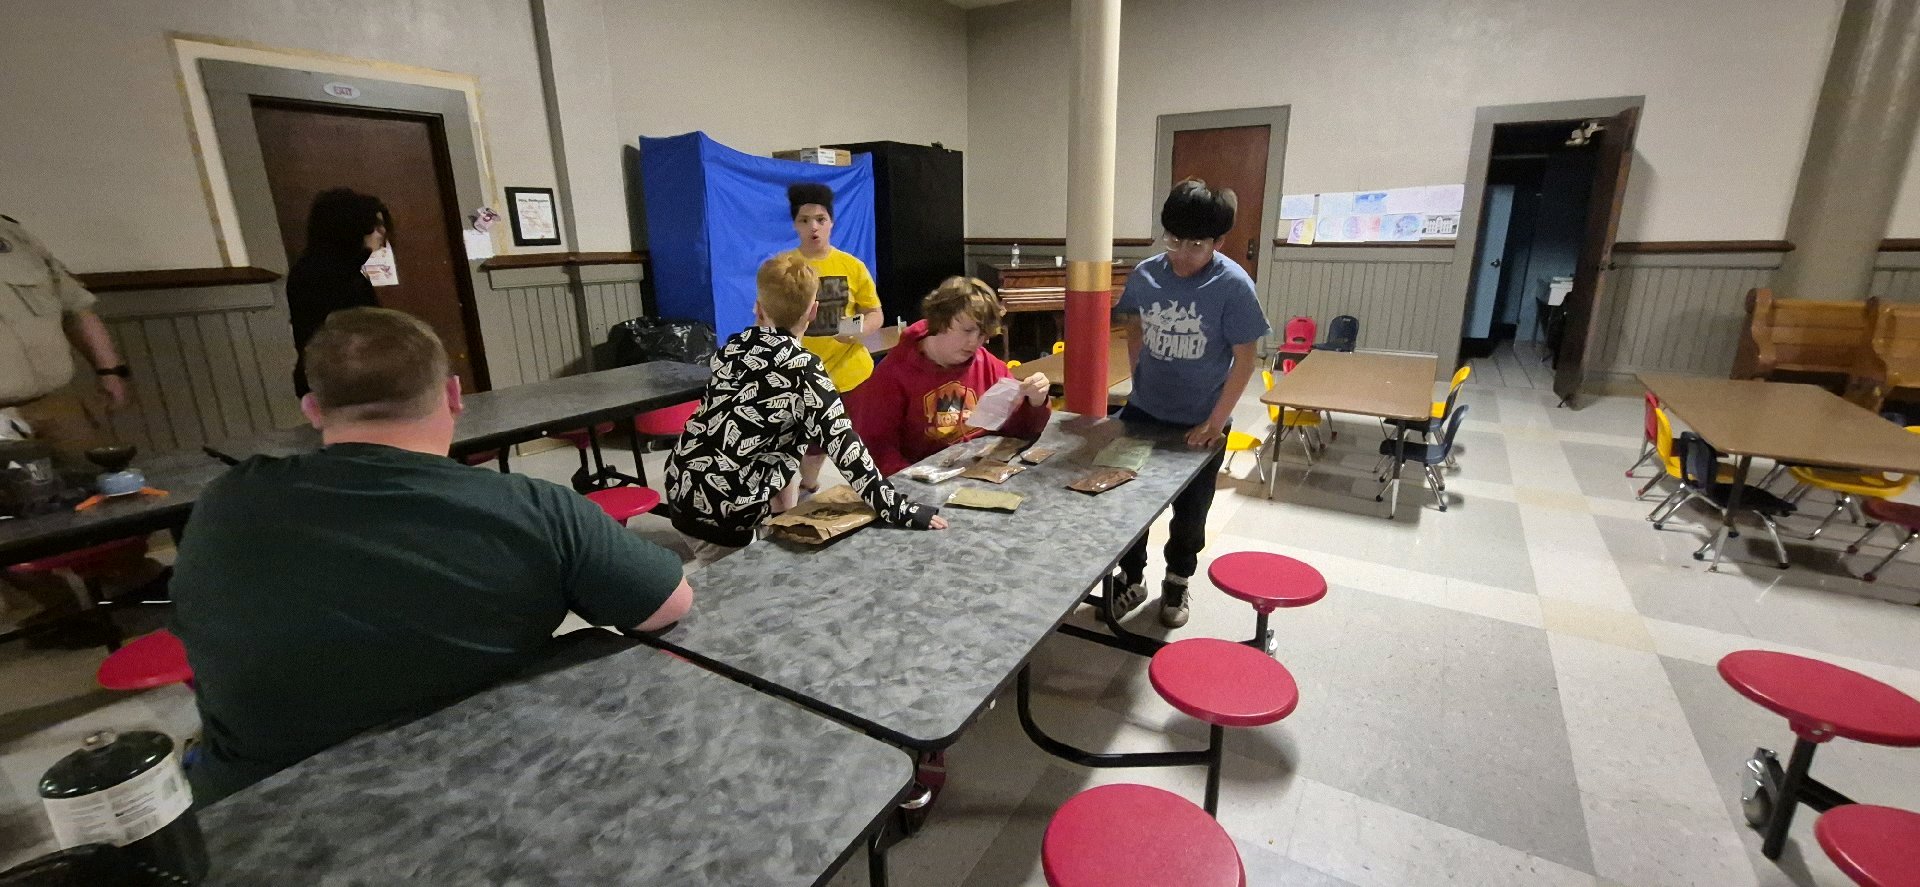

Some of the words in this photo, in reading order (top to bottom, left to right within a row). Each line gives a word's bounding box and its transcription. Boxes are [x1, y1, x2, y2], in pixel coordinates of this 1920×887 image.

[766, 399, 789, 408] NIKE
[741, 435, 760, 449] NIKE
[843, 449, 860, 467] NIKE
[735, 496, 756, 504] NIKE
